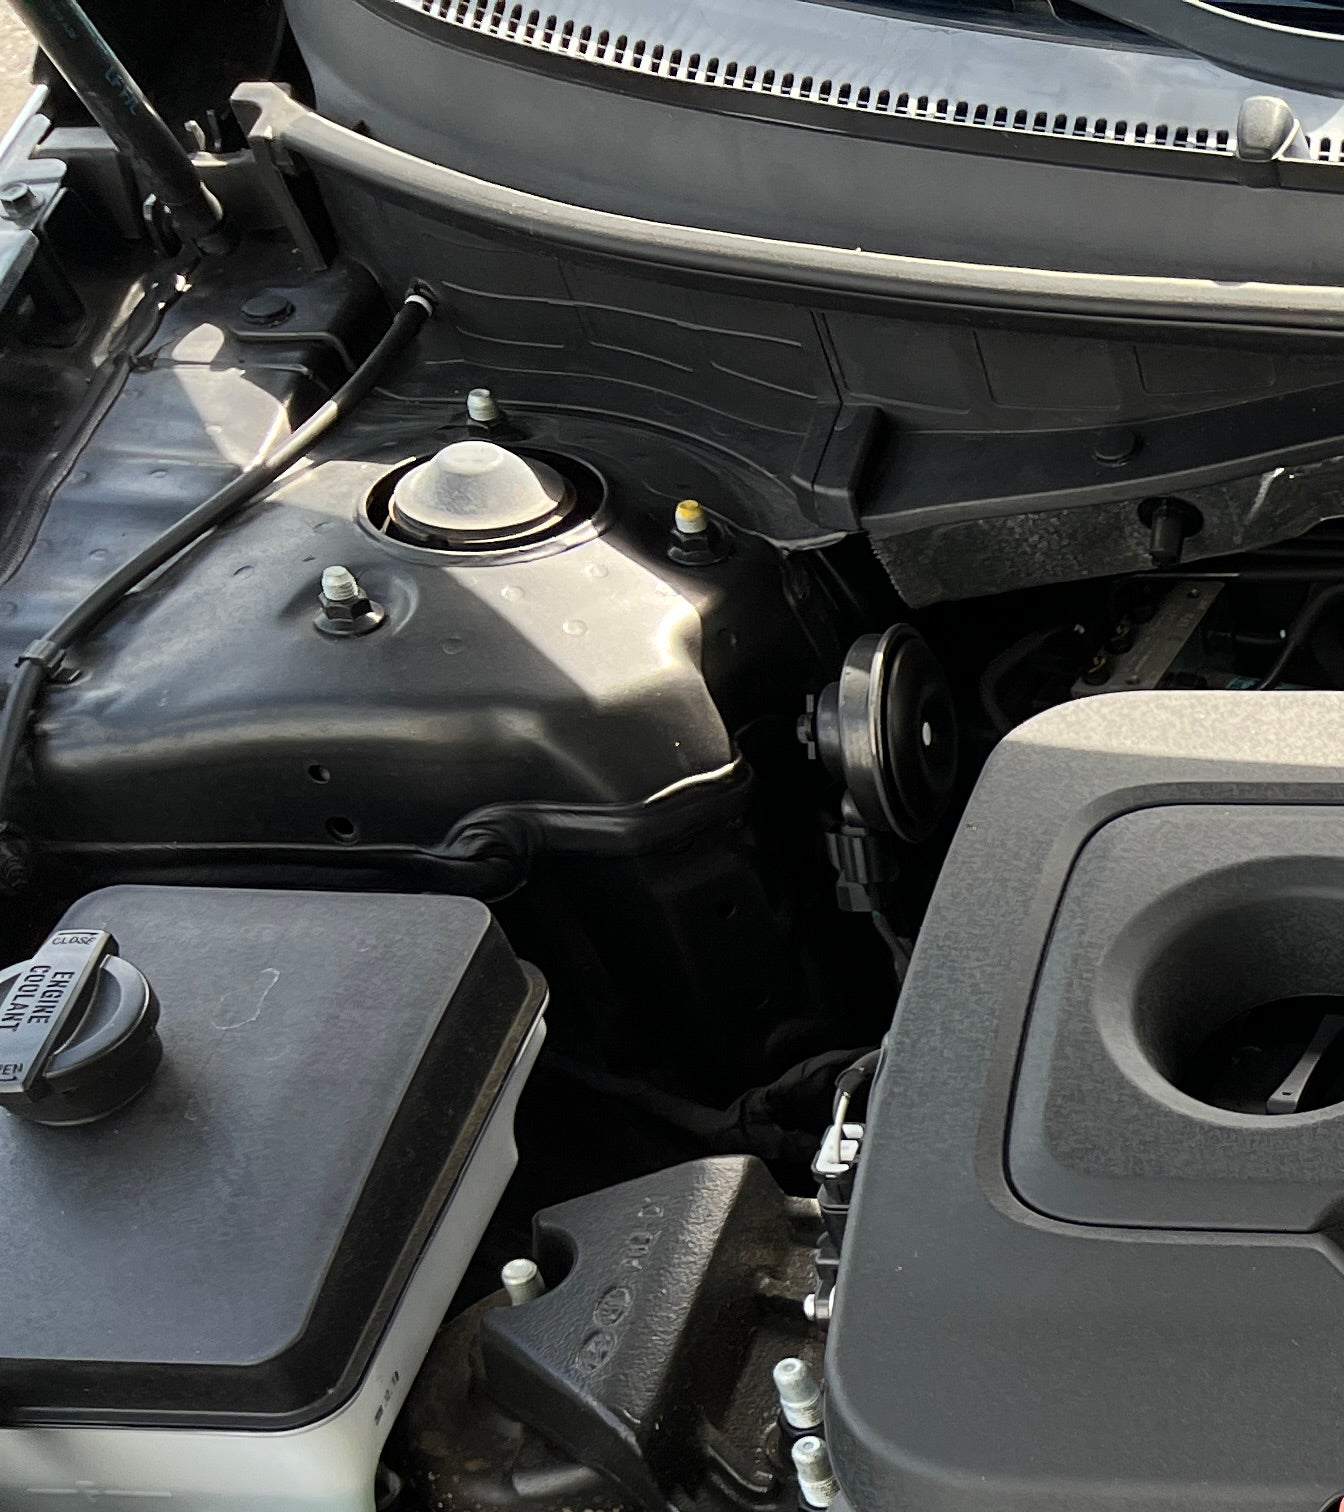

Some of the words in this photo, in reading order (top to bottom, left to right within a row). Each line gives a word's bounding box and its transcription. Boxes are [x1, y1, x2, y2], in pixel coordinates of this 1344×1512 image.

[52, 936, 96, 946] CLOSE
[0, 965, 52, 1032] COOLANT
[27, 970, 75, 1024] ENGINE
[0, 1062, 23, 1074] EN
